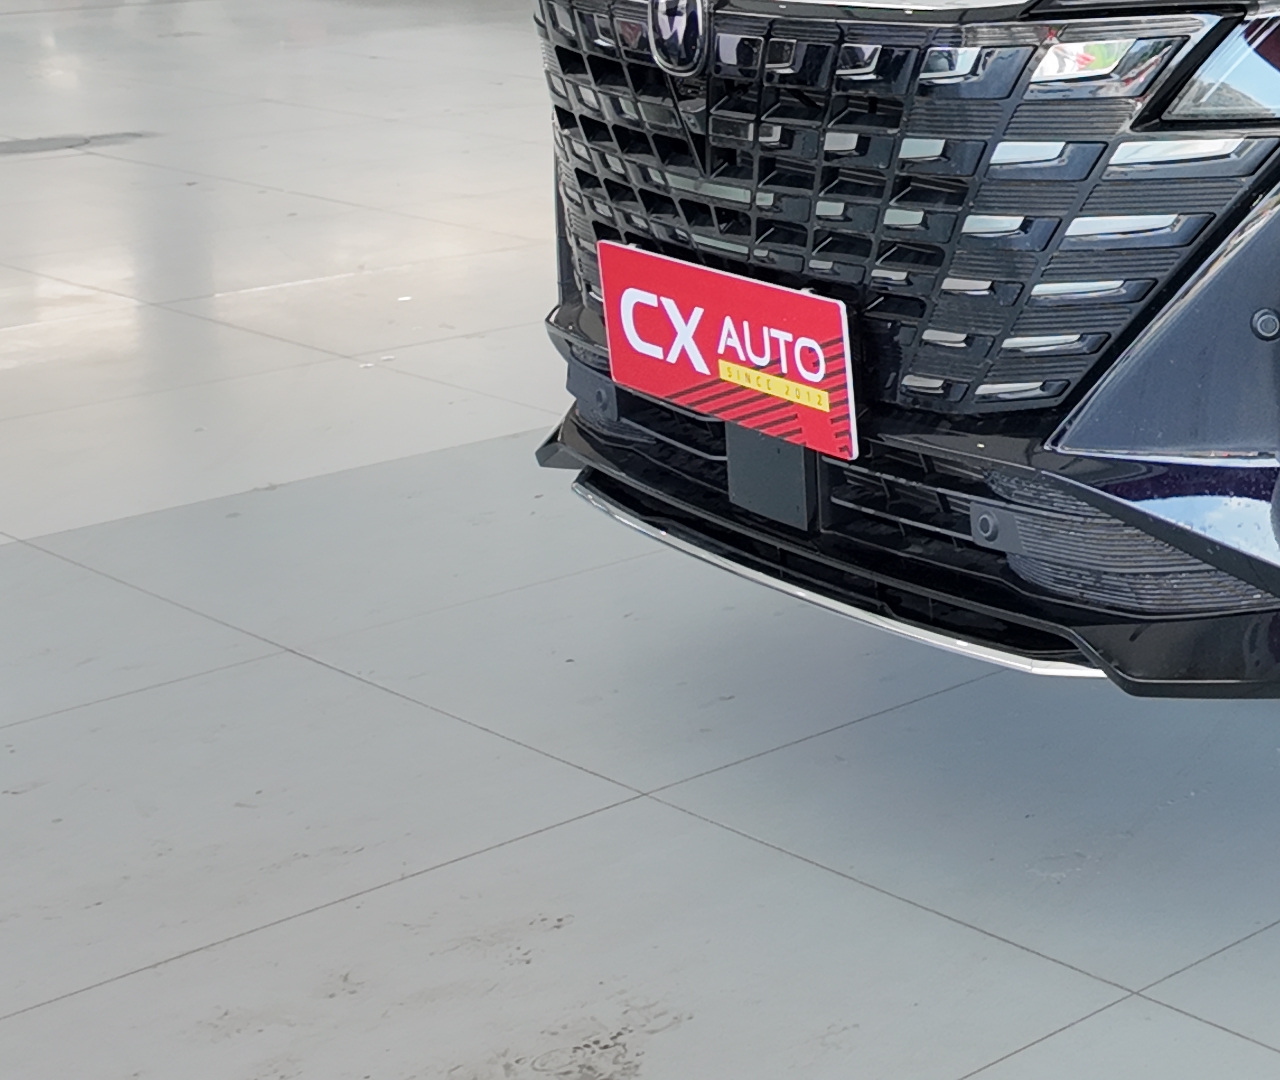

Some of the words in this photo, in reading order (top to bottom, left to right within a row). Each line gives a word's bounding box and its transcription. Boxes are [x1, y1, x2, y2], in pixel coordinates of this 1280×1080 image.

[620, 287, 711, 376] CX
[717, 315, 827, 383] AUTO
[784, 384, 824, 407] 2012
